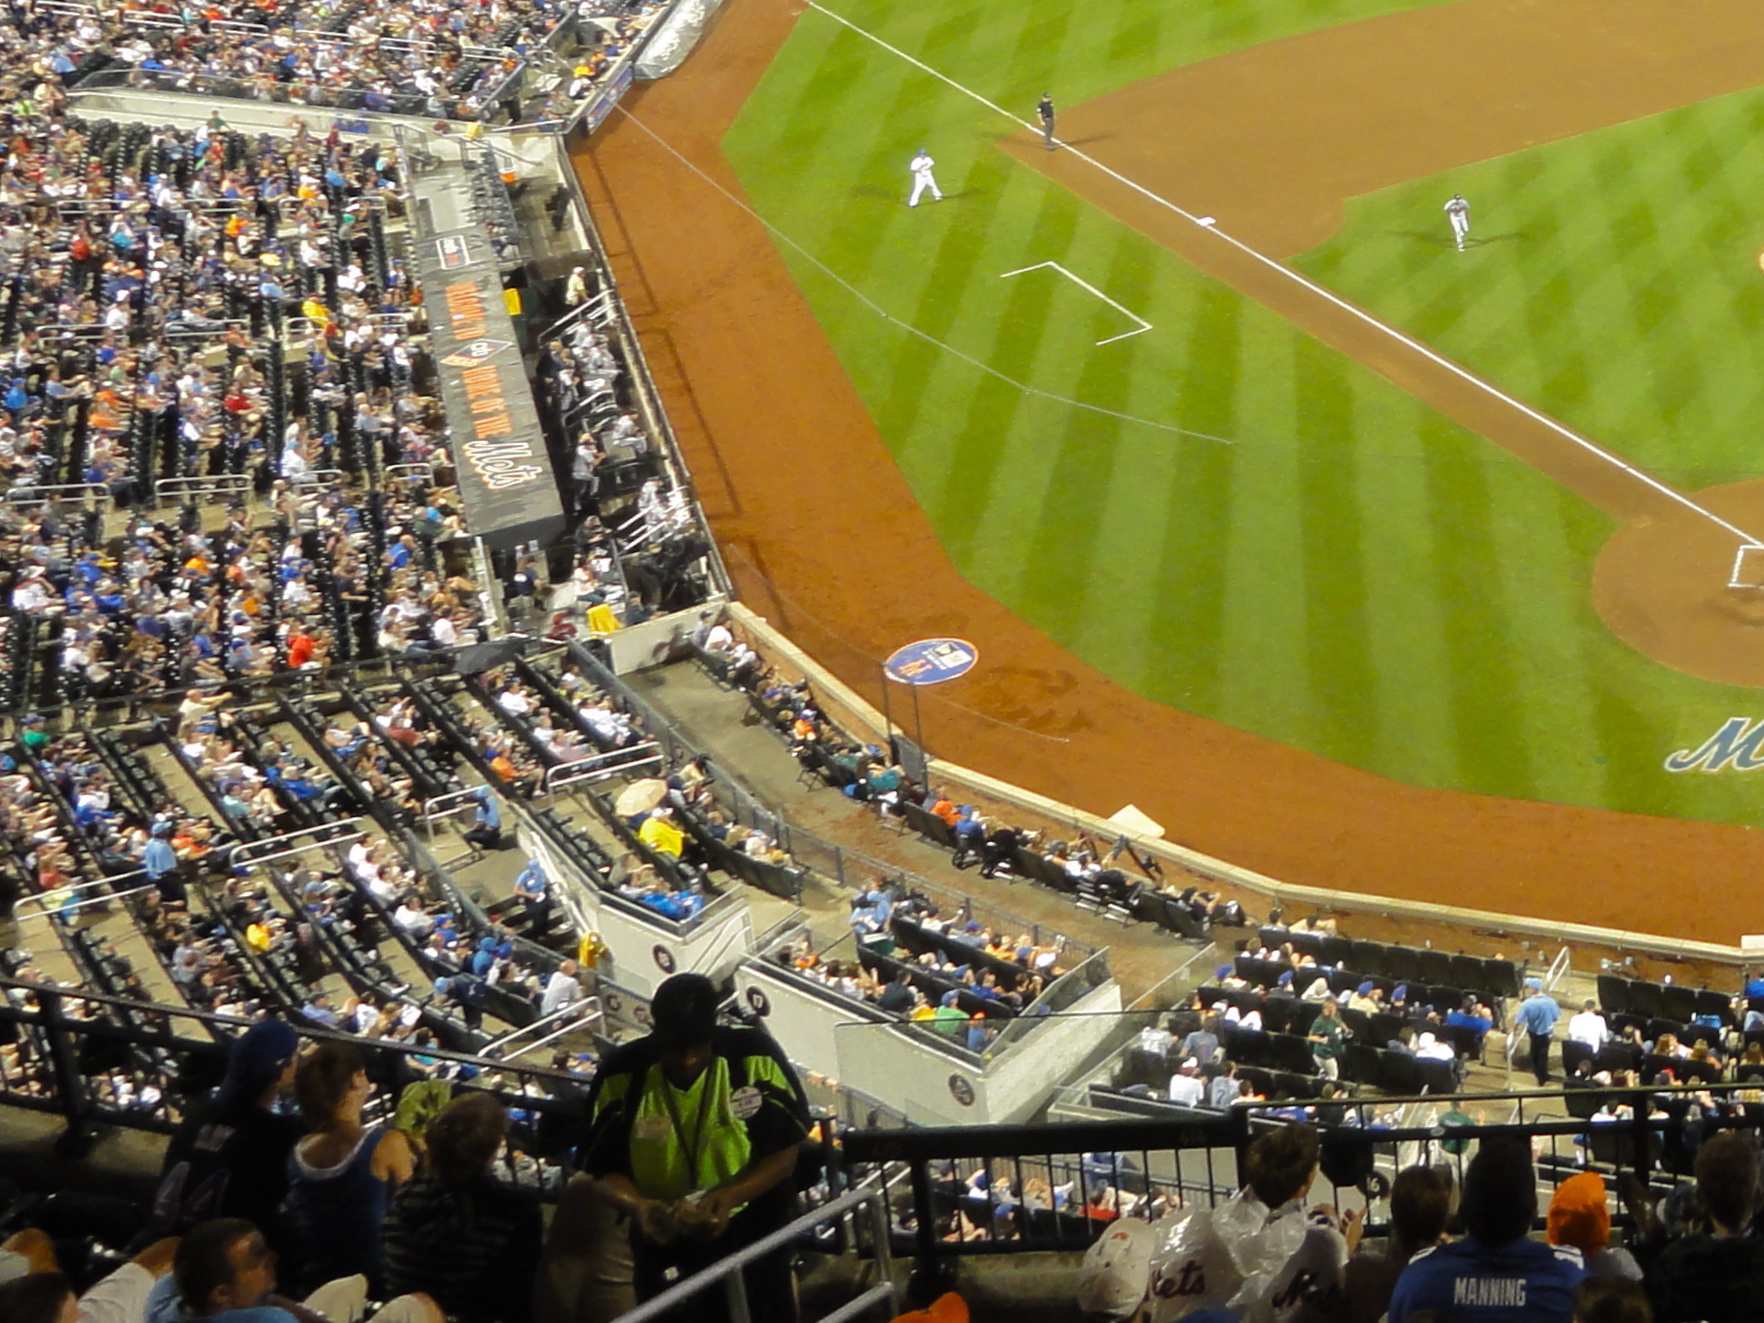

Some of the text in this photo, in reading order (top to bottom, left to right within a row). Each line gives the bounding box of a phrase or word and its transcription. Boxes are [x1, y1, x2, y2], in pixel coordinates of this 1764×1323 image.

[445, 280, 484, 323] WELCOME
[454, 324, 486, 340] TO
[462, 365, 542, 490] HOME OF THE Mets
[1454, 1277, 1526, 1307] MANNING
